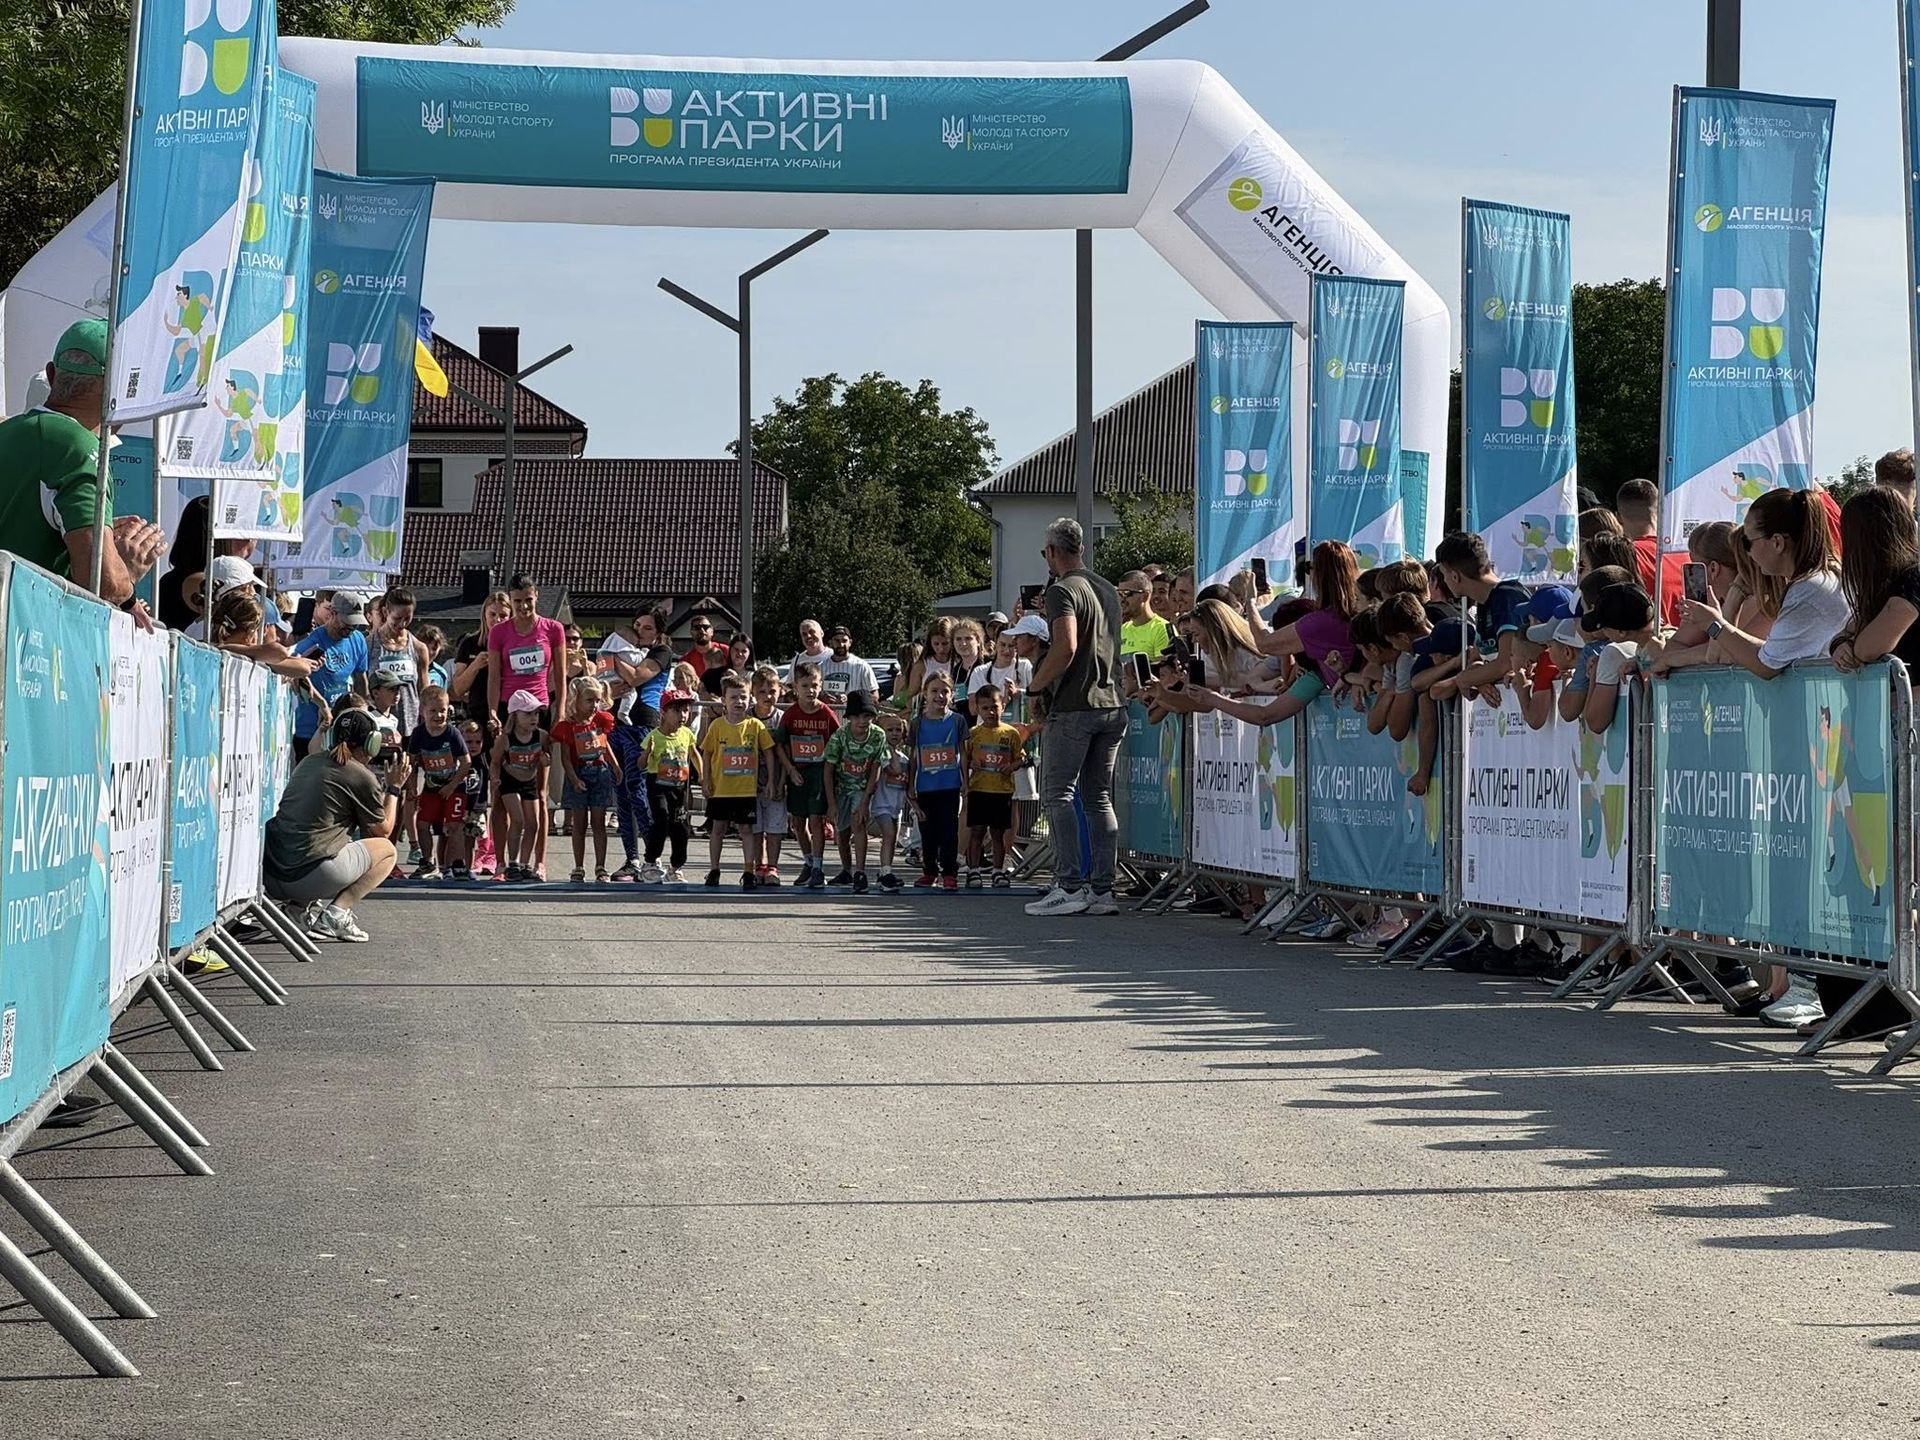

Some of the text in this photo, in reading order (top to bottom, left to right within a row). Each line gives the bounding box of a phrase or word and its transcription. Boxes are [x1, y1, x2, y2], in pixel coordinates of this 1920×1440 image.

[452, 100, 530, 112] МІНІСТЕРСТВО
[680, 89, 887, 121] АКТИВНІ
[452, 114, 554, 127] МОЛОДІ ТА СПОРТУ
[972, 114, 1046, 124] МІНІСТЕРСТВО
[680, 119, 842, 152] ПАРКИ
[972, 128, 1070, 138] МОЛОДІ ТА СПОРТУ
[609, 154, 842, 169] ПРОГРАМА ПРЕЗИДЕНТА УКРАЇНИ
[1727, 206, 1812, 224] АГЕНЦІЯ
[1252, 217, 1305, 269] МАСОВОГО СПОРТУ
[240, 251, 284, 272] ПАРКИ
[1508, 300, 1567, 318] АГЕНЦІЯ
[1687, 366, 1803, 381] АКТИВНІ ПАРКИ
[353, 409, 396, 424] ПАРКИ
[1482, 432, 1533, 444] АКТИВНІ
[1364, 473, 1393, 485] АРКИ
[1211, 500, 1249, 509] АКТИВНІ
[389, 663, 406, 673] 024
[519, 655, 537, 666] 004
[799, 744, 817, 753] 520
[730, 755, 749, 766] 517
[929, 752, 948, 762] 515
[985, 754, 1003, 764] 537
[1196, 760, 1231, 793] АКТИВНІ
[1358, 766, 1395, 802] ПАРКИ
[1468, 767, 1569, 811] АКТИВНІ ПАРКИ
[1661, 769, 1806, 824] АКТИВНІ ПАРКИ
[1660, 824, 1706, 850] ПРОГРАМА
[1763, 829, 1806, 859] УКРАЇНИ
